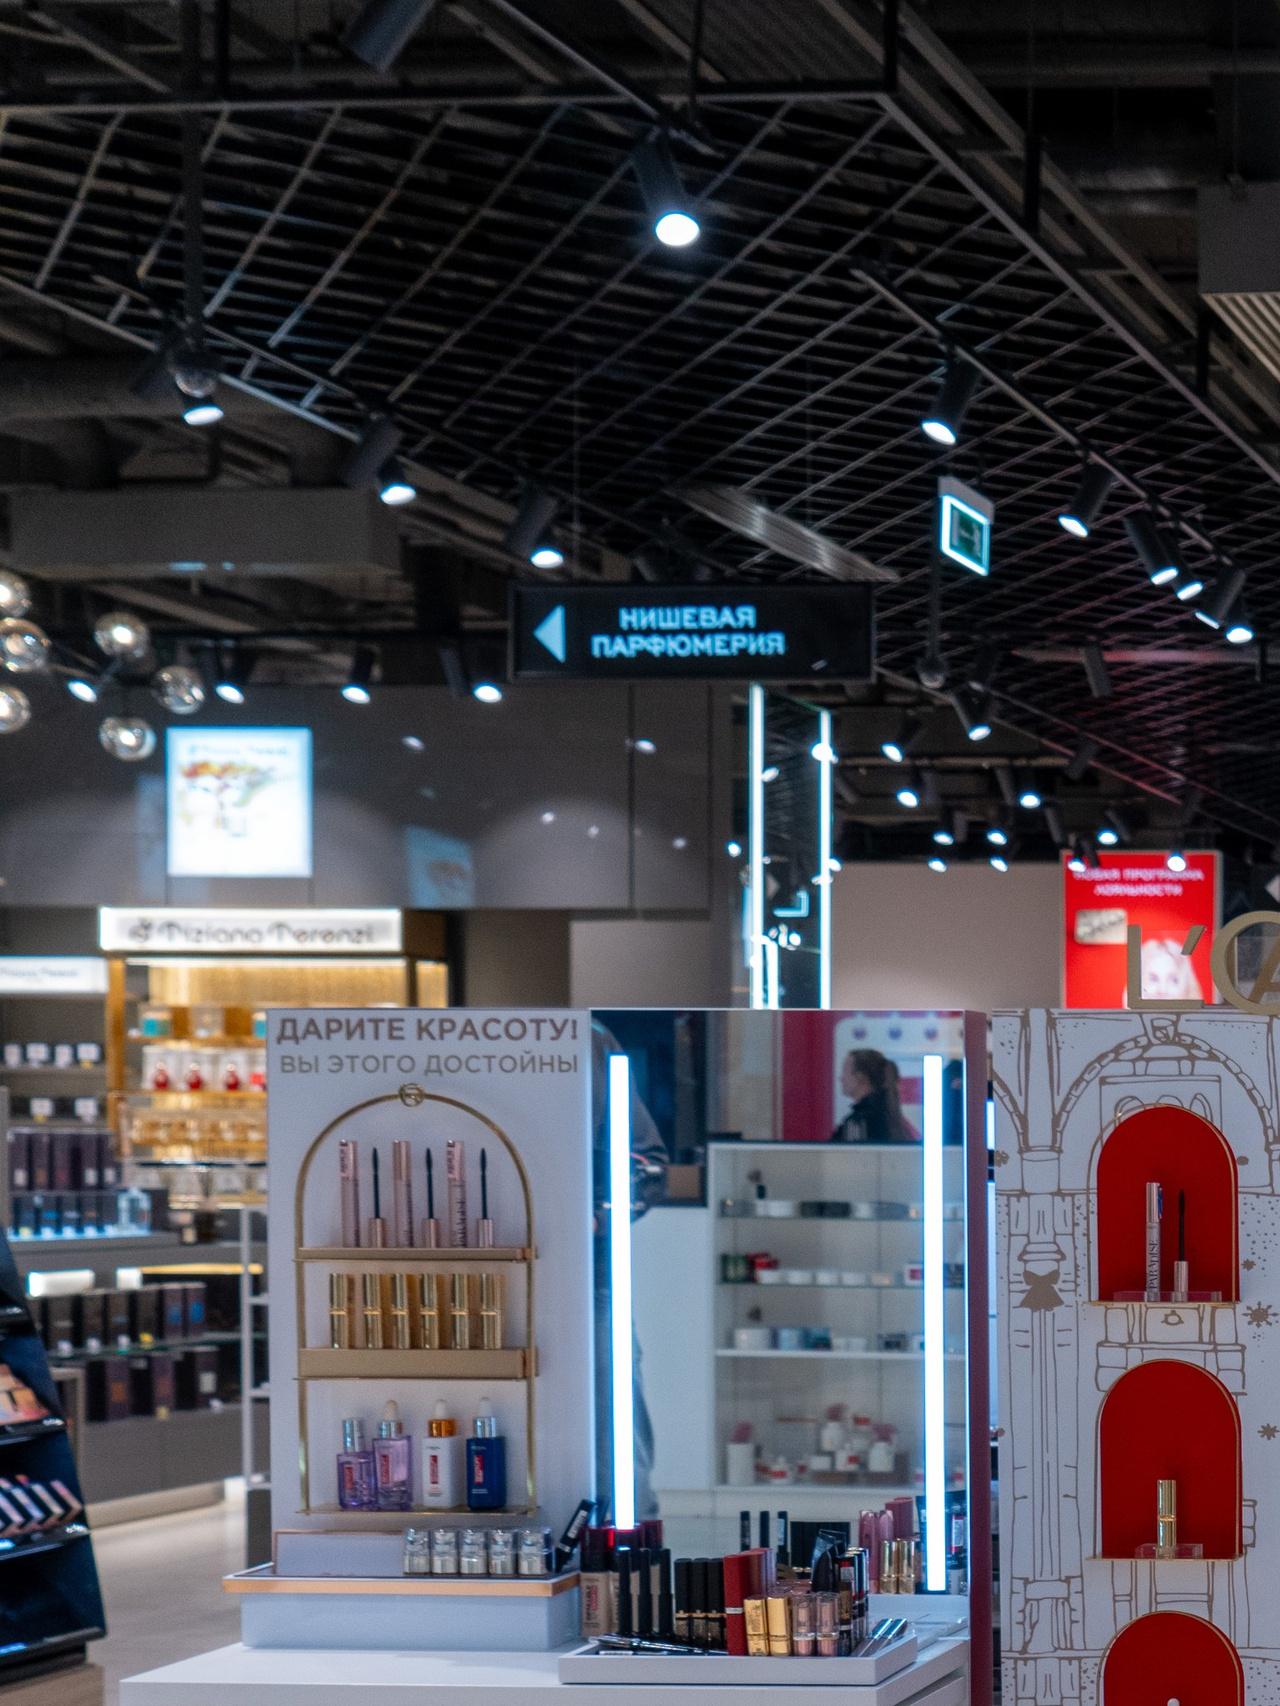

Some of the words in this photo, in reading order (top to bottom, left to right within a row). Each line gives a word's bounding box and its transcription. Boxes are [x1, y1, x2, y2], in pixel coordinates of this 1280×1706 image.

[619, 605, 757, 630] НИШЕВАЯ
[591, 632, 786, 658] ПАРФЮМЕРИЯ
[276, 1017, 406, 1044] ДАРИТЕ
[416, 1017, 578, 1042] КРАСОТУ!
[280, 1055, 319, 1074] ВЫ
[328, 1055, 416, 1074] ЭТОГО
[424, 1050, 578, 1076] ДОСТОЙНЫ
